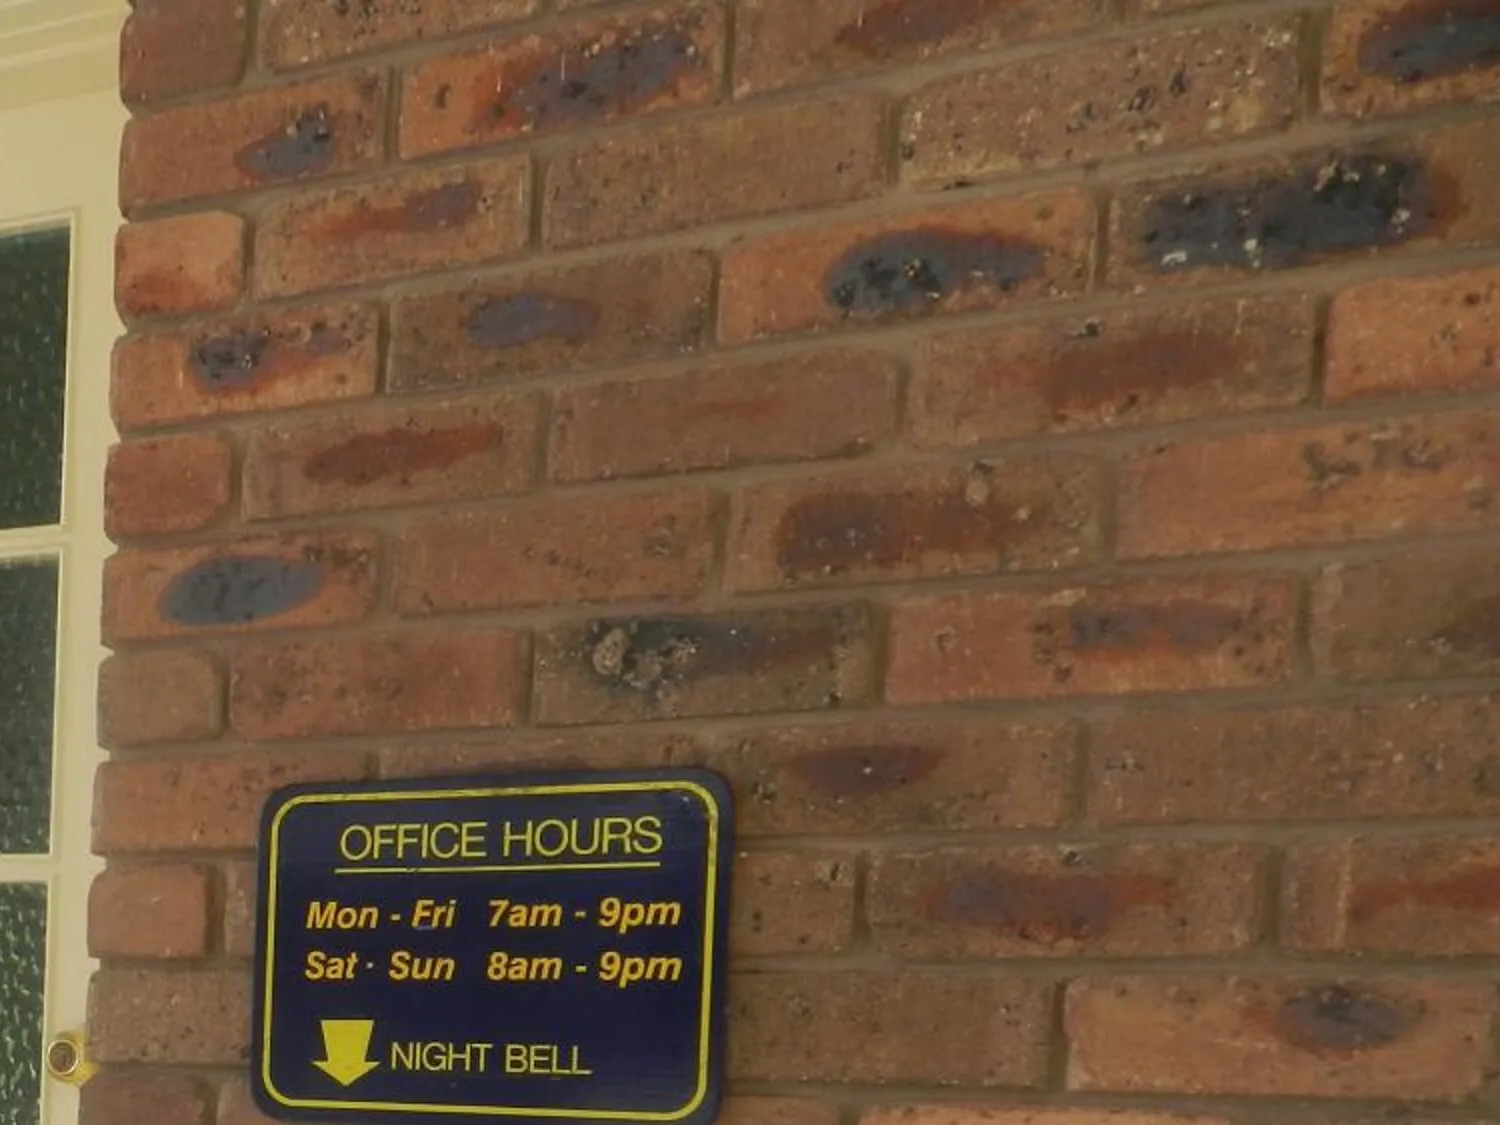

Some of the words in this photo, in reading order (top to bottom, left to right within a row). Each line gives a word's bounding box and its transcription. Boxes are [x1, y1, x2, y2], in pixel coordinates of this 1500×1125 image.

[340, 821, 488, 861] OFFICE
[502, 815, 664, 857] HOURS
[306, 901, 379, 929] Mon
[411, 899, 457, 928] Fri
[488, 899, 563, 928] 7am
[598, 897, 682, 934] 9pm
[305, 950, 359, 980] Sat
[389, 950, 456, 981] Sun
[487, 951, 563, 981] 8am
[598, 951, 683, 989] 9pm
[390, 1042, 493, 1074] NIGHT
[504, 1045, 593, 1076] BELL
